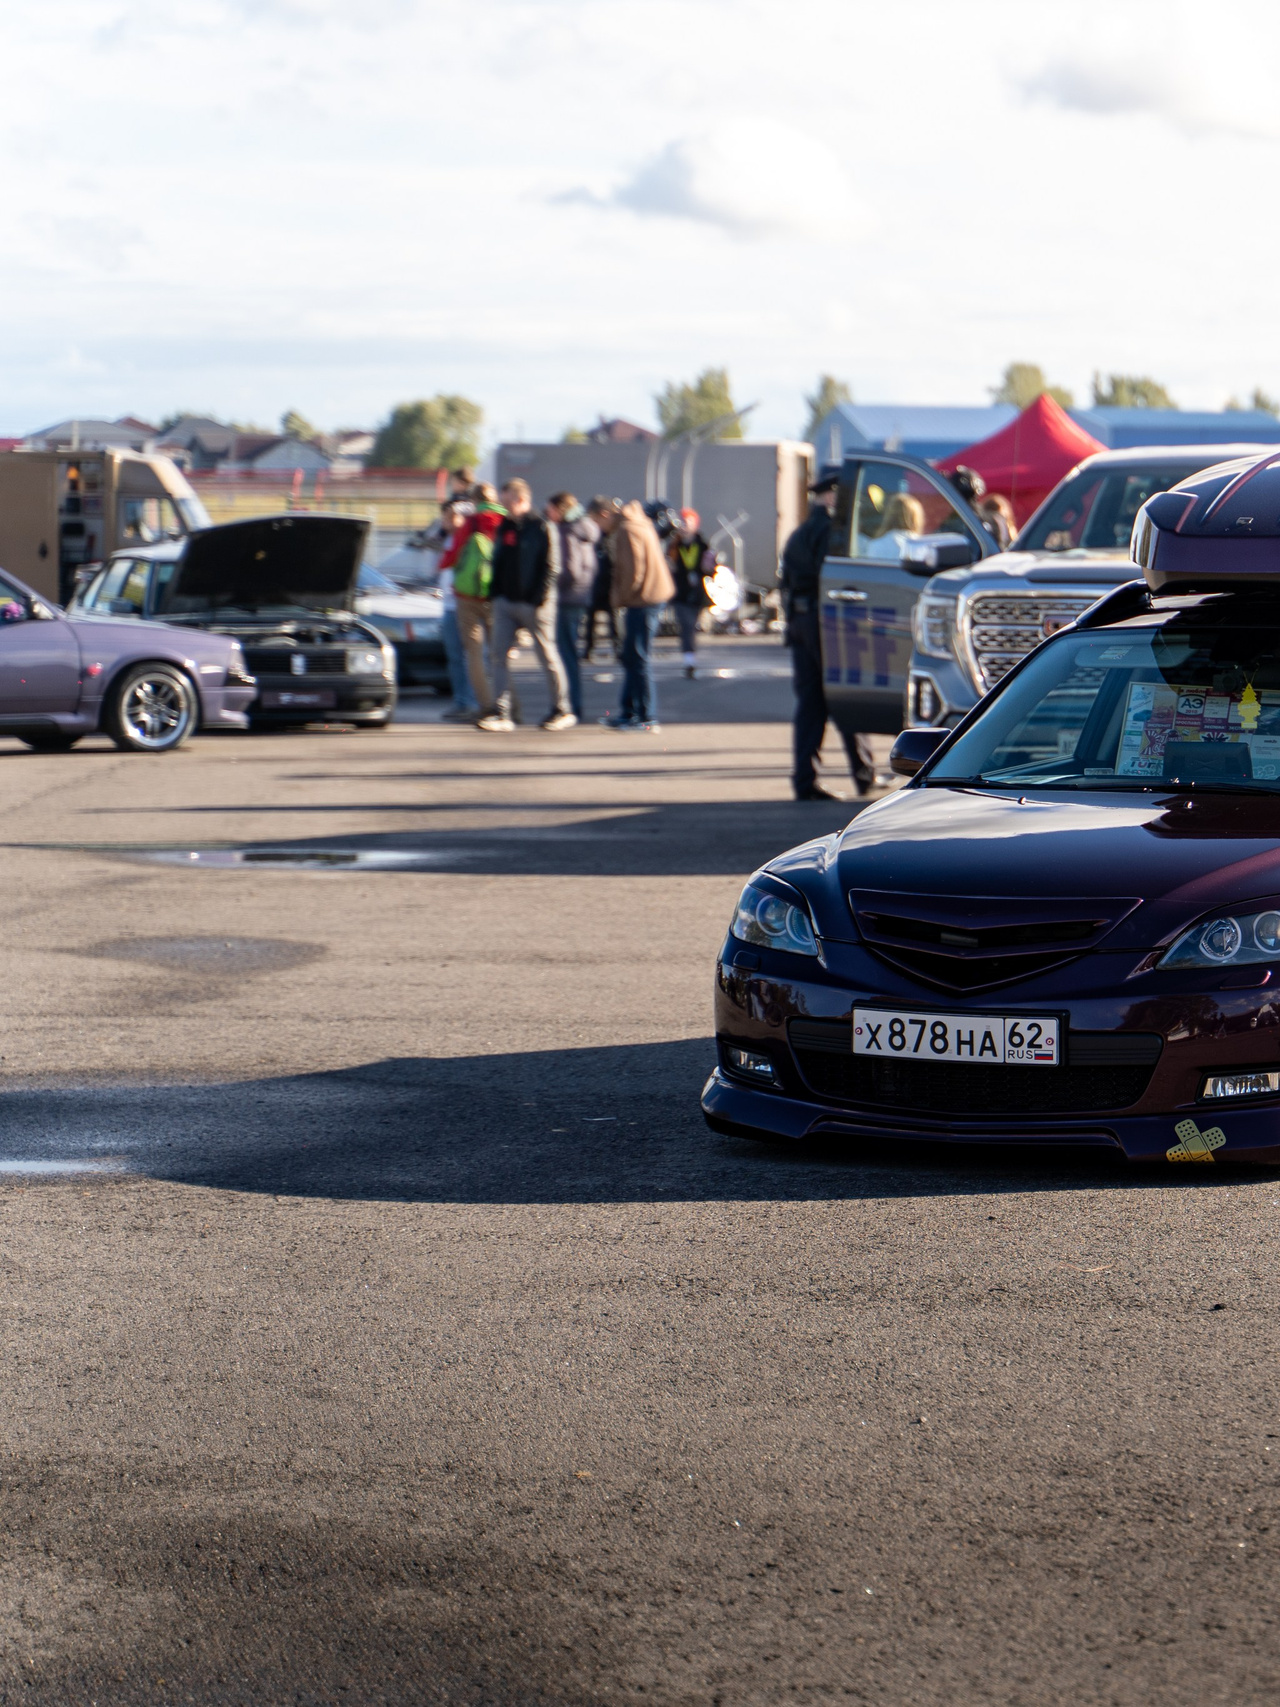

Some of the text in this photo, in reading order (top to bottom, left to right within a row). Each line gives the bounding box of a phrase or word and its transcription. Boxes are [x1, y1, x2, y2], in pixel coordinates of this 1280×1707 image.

[1181, 698, 1204, 709] АЭ
[865, 1017, 1043, 1058] Х878НА 62
[1007, 1049, 1034, 1059] RUS
